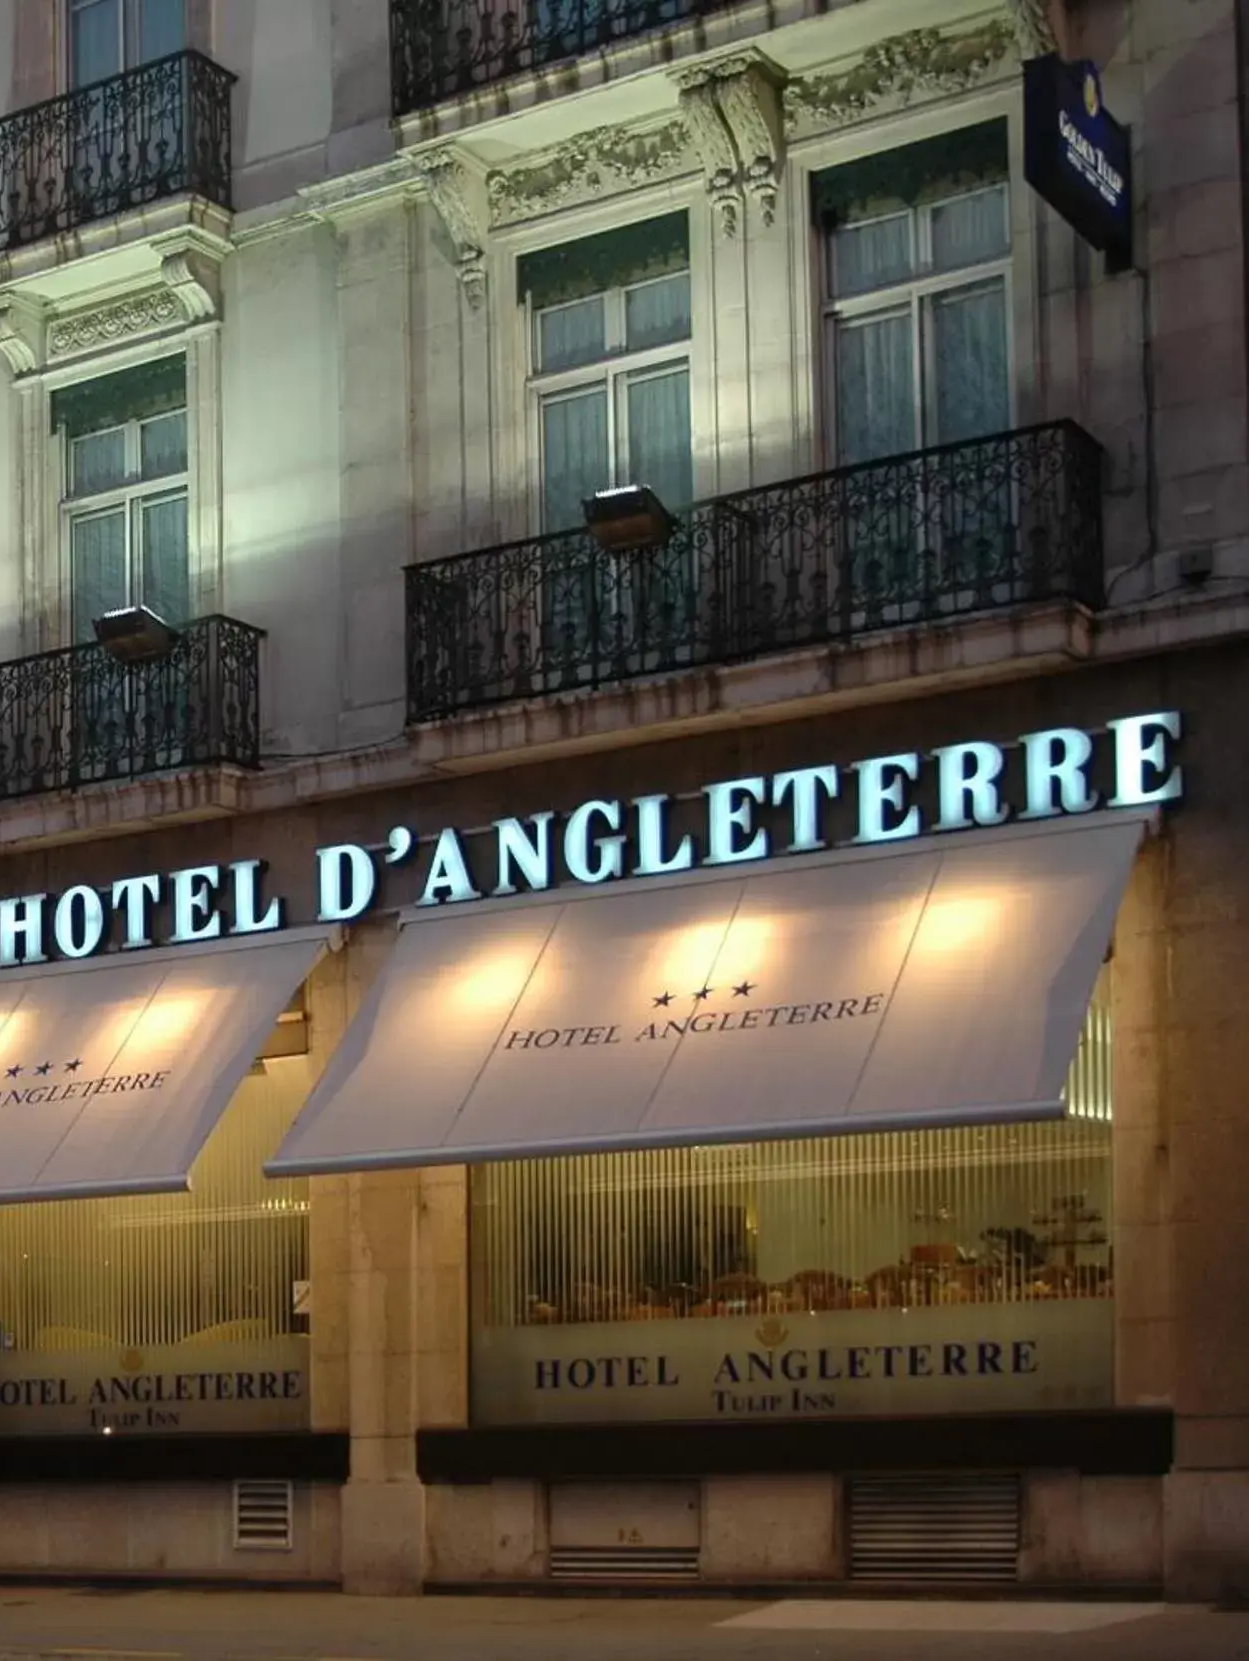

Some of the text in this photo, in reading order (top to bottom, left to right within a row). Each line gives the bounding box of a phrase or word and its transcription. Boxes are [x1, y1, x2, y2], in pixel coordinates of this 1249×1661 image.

[316, 711, 1182, 921] D'ANGLETERRE
[505, 993, 884, 1050] HOTEL ANGLETERRE
[535, 1340, 1039, 1389] HOTEL ANGLETERRE
[89, 1370, 302, 1400] ANGLETERRE
[791, 1389, 836, 1410] INN
[147, 1407, 180, 1426] INN
